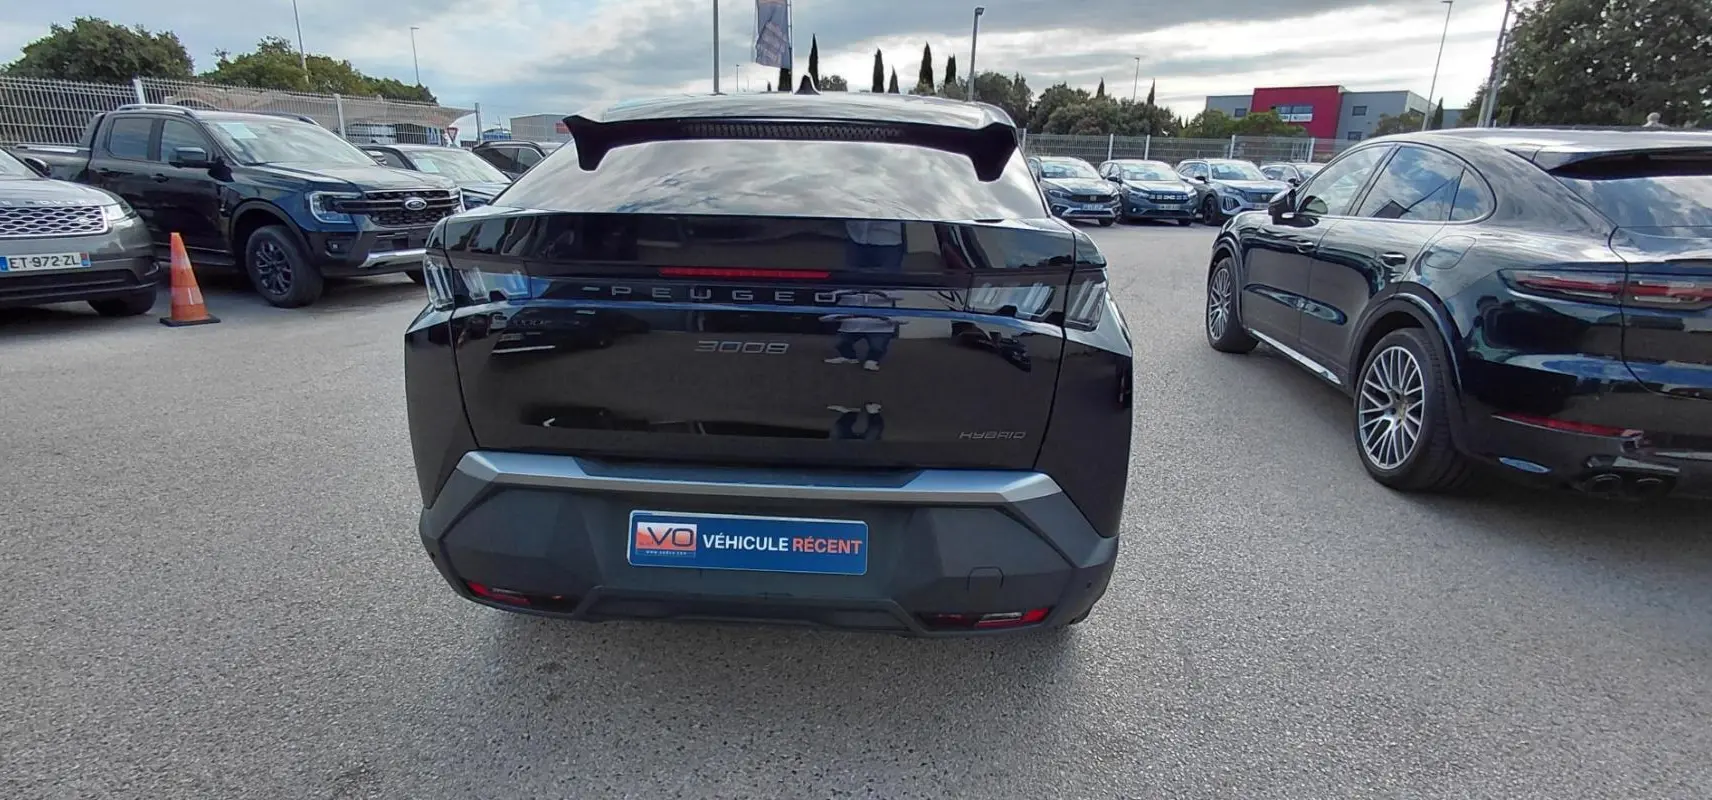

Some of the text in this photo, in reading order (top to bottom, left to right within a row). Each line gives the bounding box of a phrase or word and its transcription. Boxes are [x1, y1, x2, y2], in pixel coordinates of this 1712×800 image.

[611, 286, 870, 303] PEUGEOT
[695, 340, 789, 354] 3008
[959, 431, 1027, 440] HYBRID
[647, 526, 695, 547] VO
[703, 532, 863, 554] VÉHICULE RÉCENT
